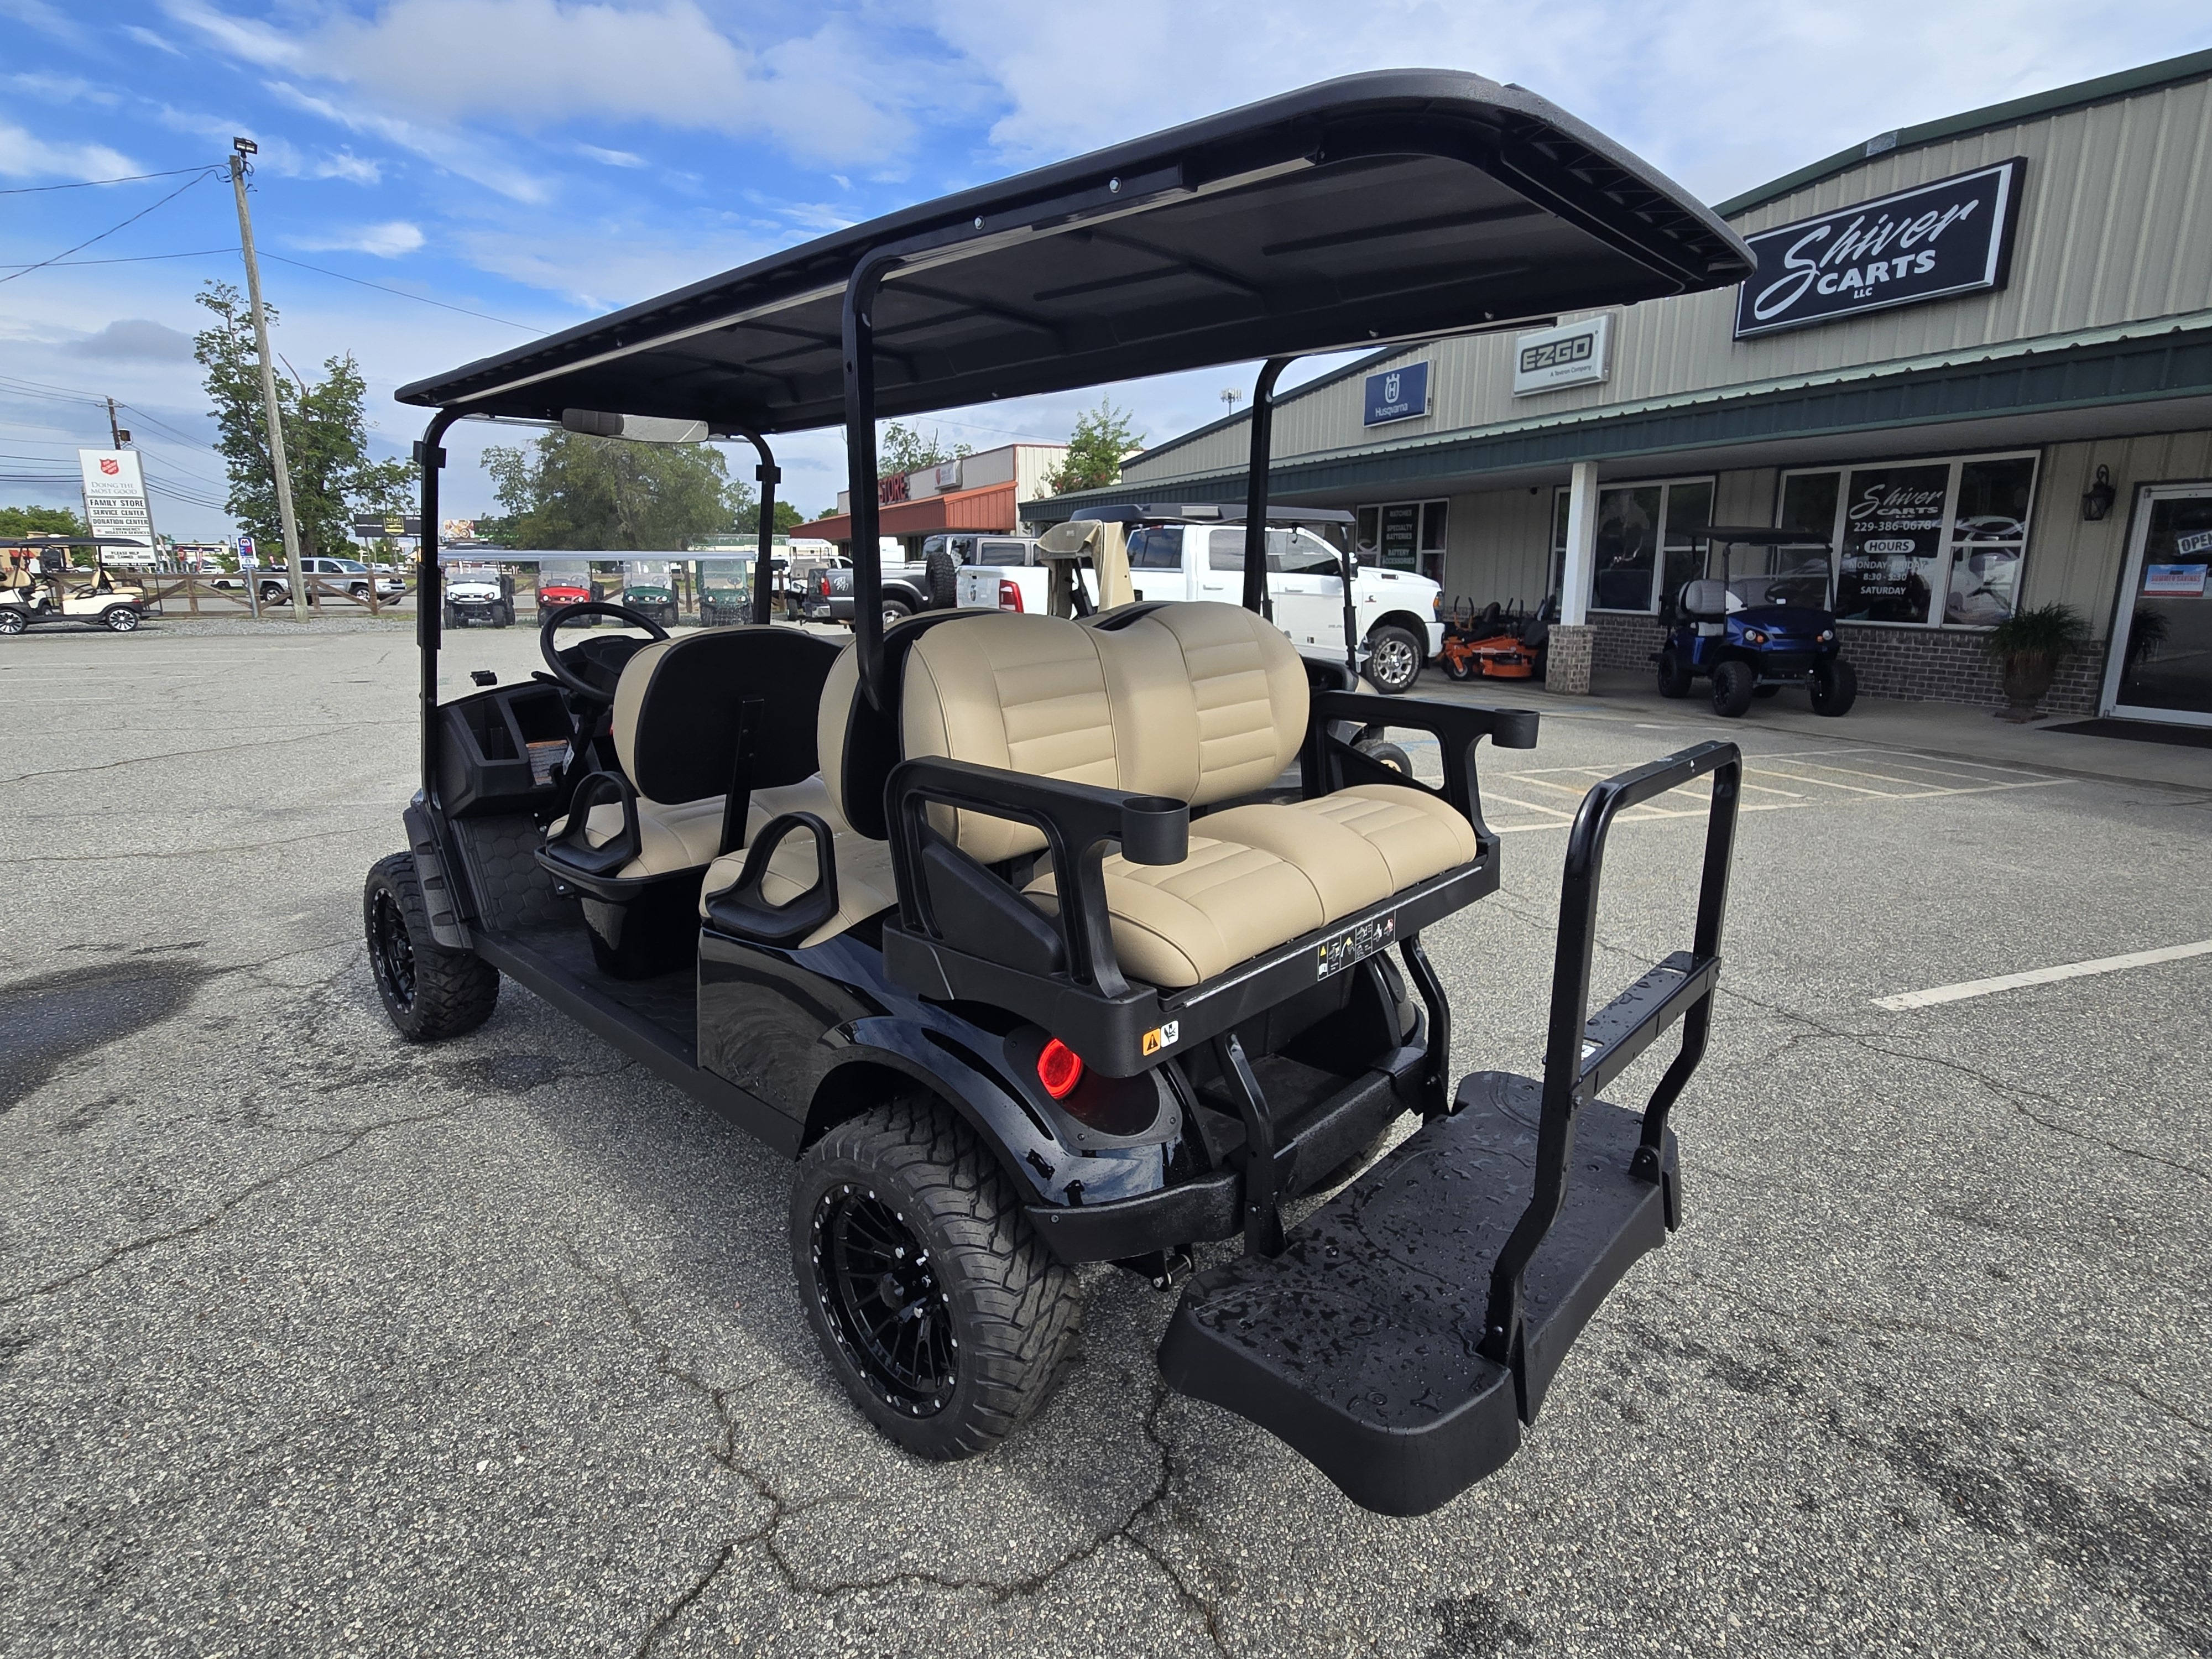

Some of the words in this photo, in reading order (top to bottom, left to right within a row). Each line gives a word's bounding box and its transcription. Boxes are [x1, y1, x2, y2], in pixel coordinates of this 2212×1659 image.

[1754, 199, 1979, 320] Shiver
[1817, 249, 1936, 295] CARTS
[1854, 287, 1872, 299] LLC
[1522, 336, 1590, 371] EZGO
[1571, 365, 1592, 374] Company
[1375, 403, 1408, 418] Husqvarna
[878, 472, 906, 504] STORE
[1849, 484, 1944, 520] Shiver
[1877, 507, 1938, 515] CARTS
[1386, 524, 1413, 532] SPECIALTY
[1854, 520, 1932, 532] 229-386-0678
[1869, 541, 1910, 551] HOURS
[1849, 561, 1888, 570] MONDAY
[1863, 572, 1882, 581] 8:30
[1888, 572, 1907, 581] 5:30
[1860, 586, 1907, 595] SATURDAY
